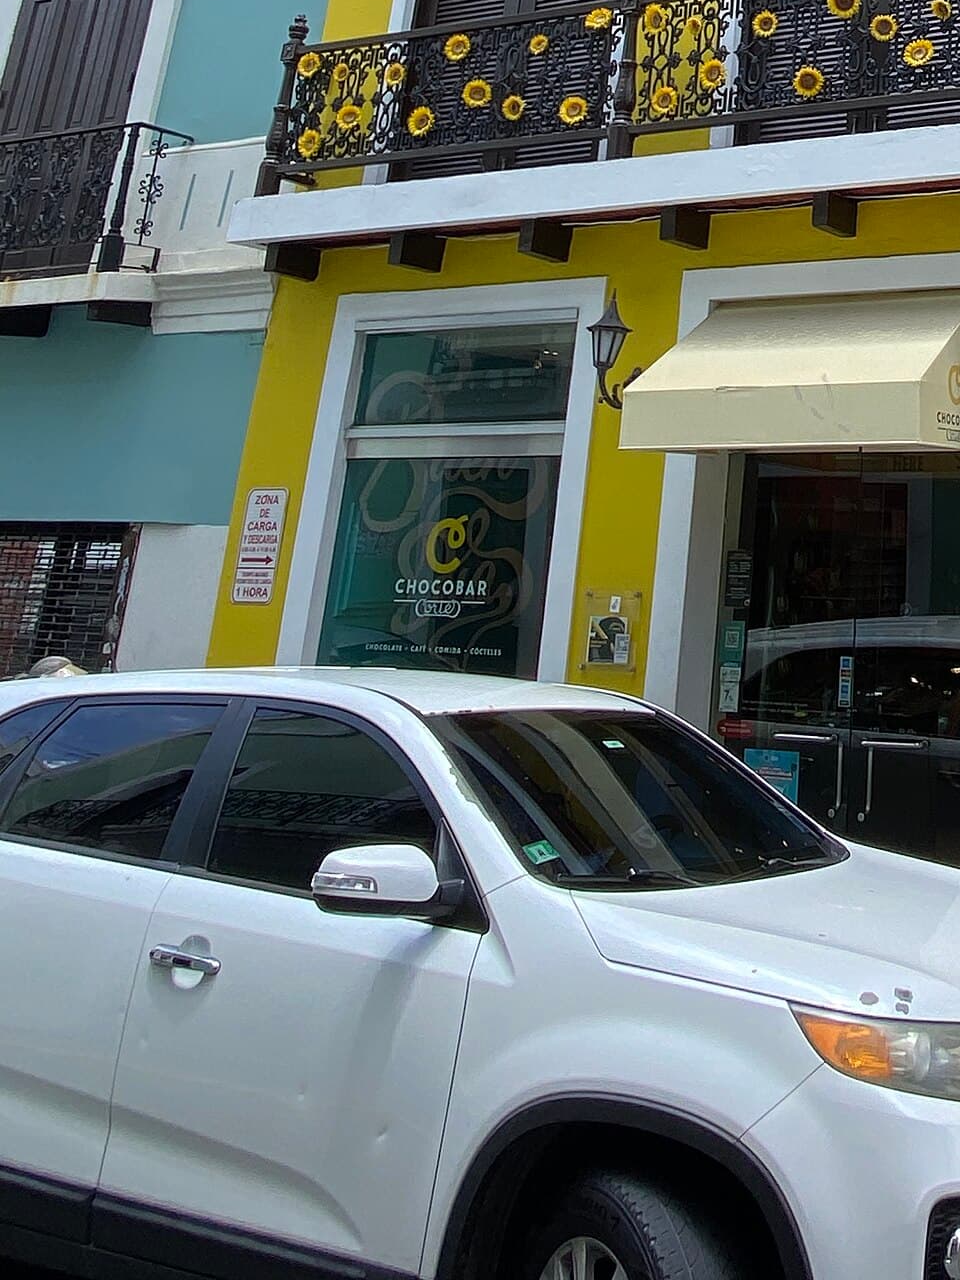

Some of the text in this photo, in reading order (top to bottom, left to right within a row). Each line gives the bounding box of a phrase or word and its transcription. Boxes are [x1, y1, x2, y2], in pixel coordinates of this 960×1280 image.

[254, 495, 279, 505] ZONA
[259, 508, 270, 518] DE
[247, 521, 277, 531] CARGA
[247, 534, 278, 544] DESCARGA
[394, 578, 488, 596] CHOCOBAR
[242, 587, 268, 598] HORA
[365, 643, 402, 652] CHOCOLATE
[434, 646, 461, 655] COMIDA
